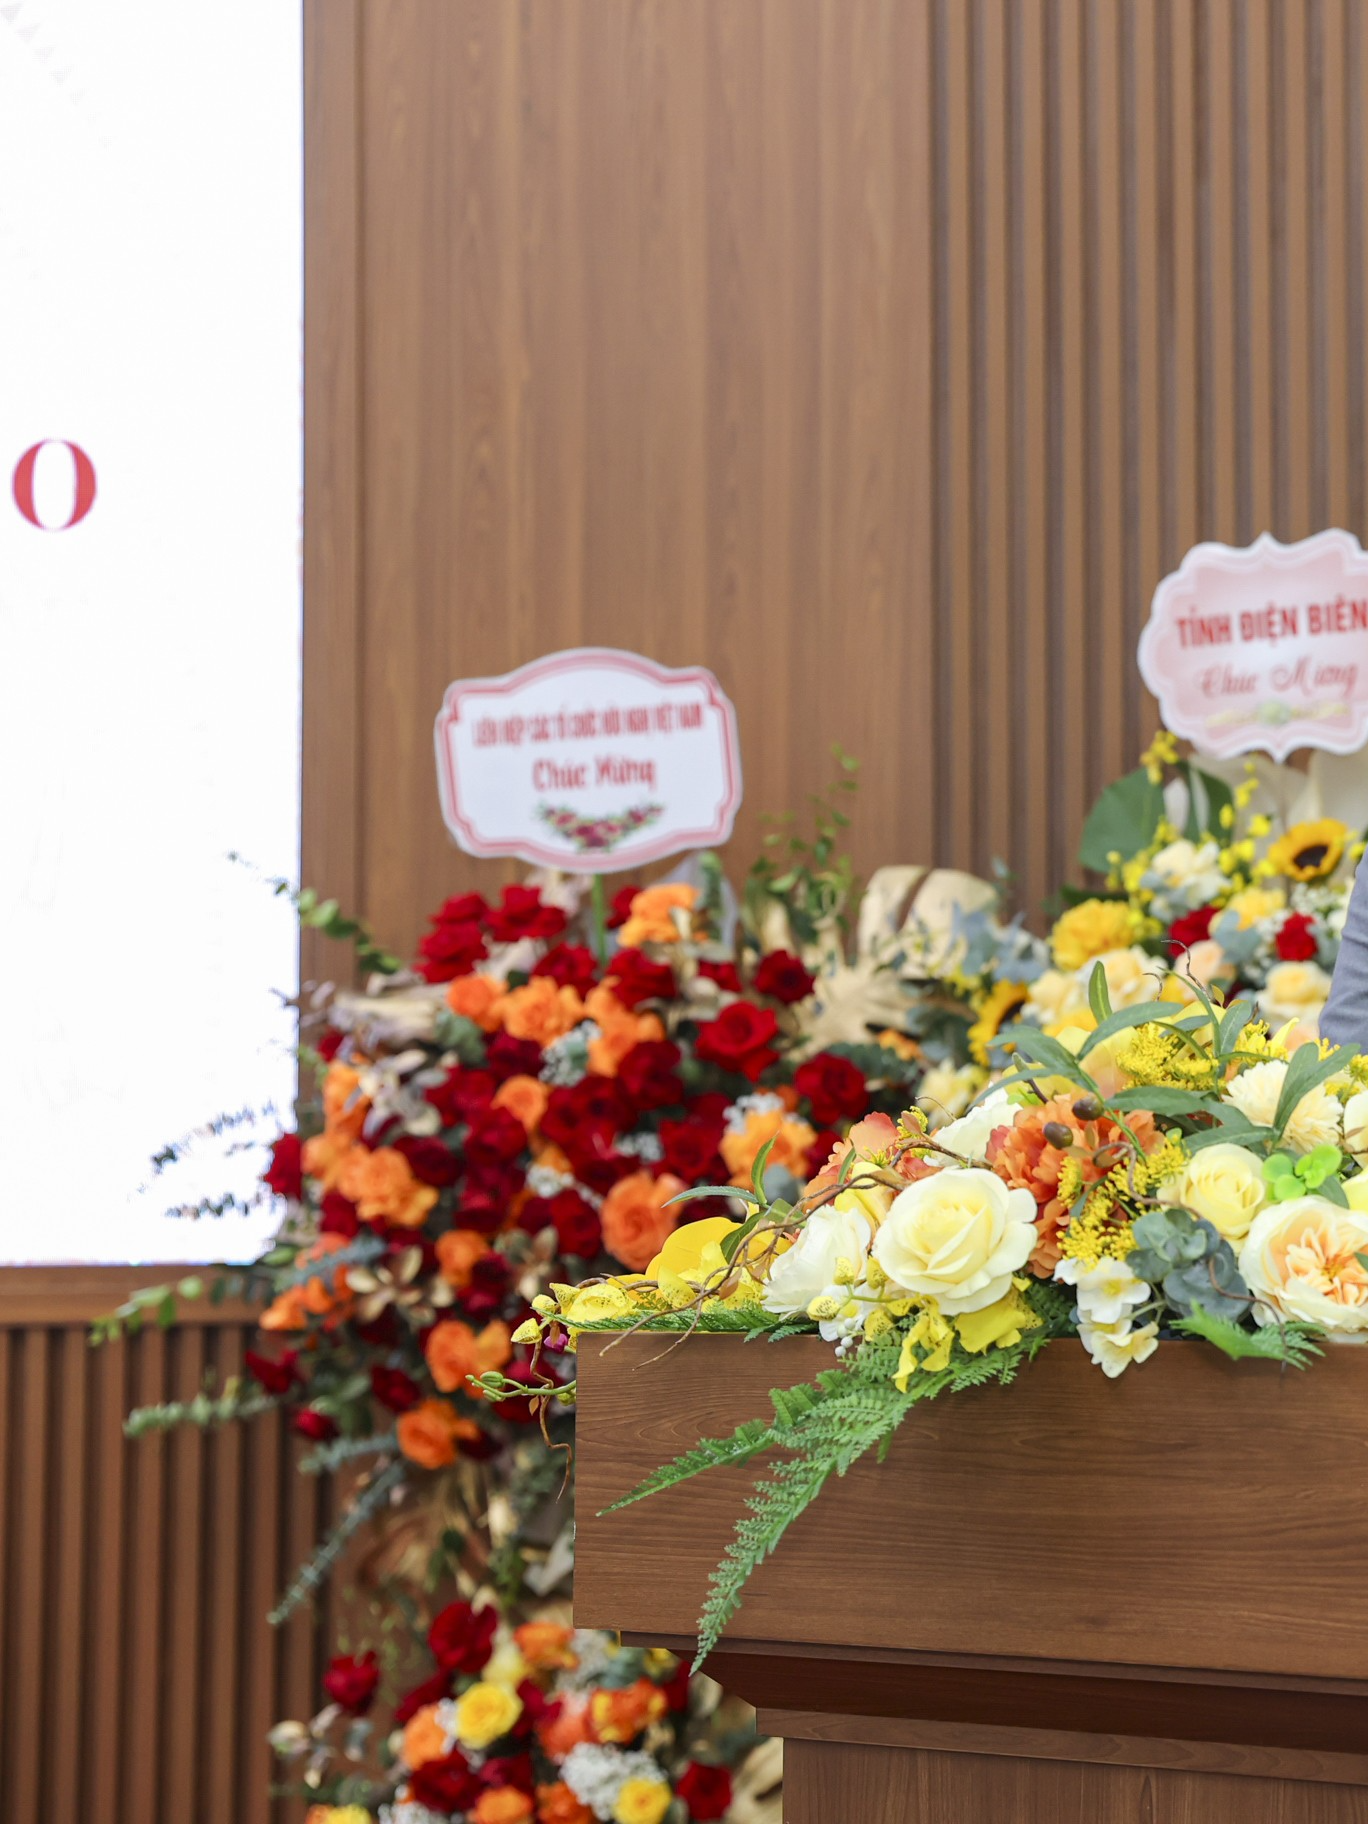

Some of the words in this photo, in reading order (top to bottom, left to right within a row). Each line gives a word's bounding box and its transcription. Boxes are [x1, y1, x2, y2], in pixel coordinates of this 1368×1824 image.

[1240, 602, 1298, 647] ĐIỆN
[1306, 595, 1368, 636] BIÊN
[533, 756, 585, 791] Chúc
